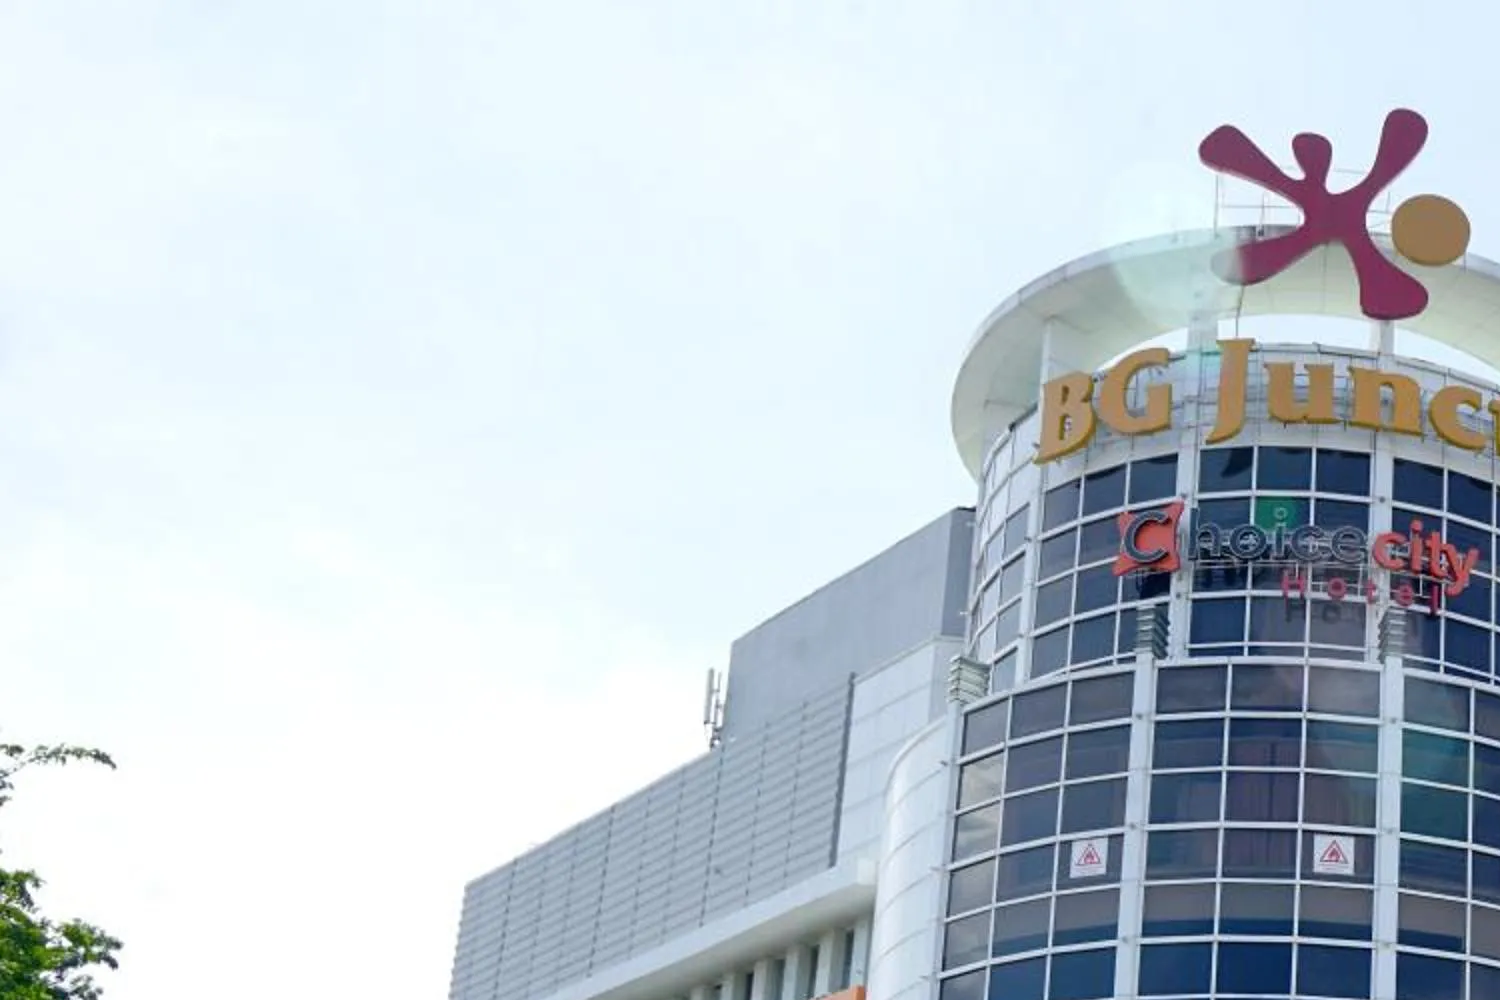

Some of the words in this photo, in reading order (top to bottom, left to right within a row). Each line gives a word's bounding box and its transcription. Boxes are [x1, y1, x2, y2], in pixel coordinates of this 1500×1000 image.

[1033, 348, 1173, 466] BG
[1124, 506, 1366, 564] Choice
[1372, 519, 1479, 597] city
[1282, 566, 1440, 615] Hotel
